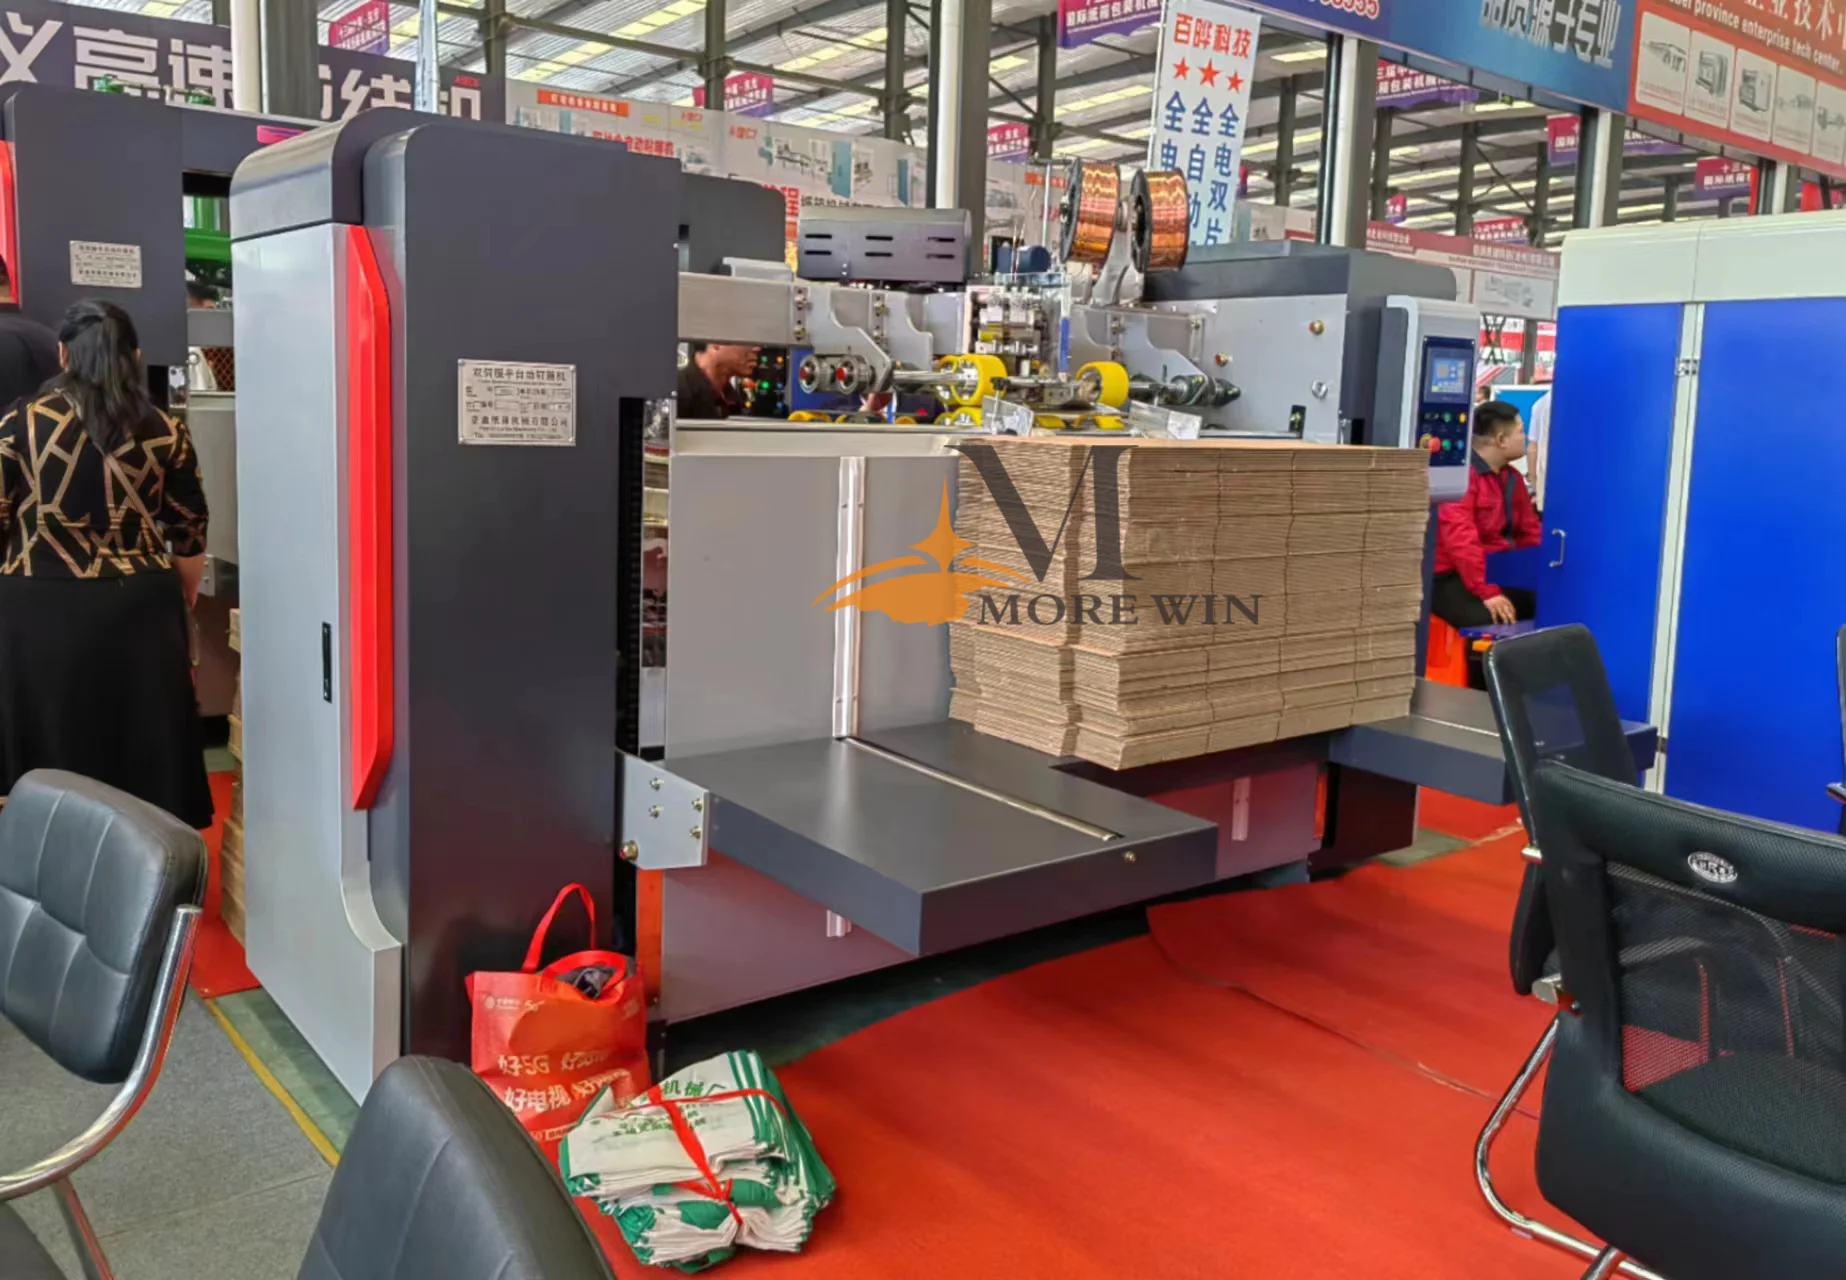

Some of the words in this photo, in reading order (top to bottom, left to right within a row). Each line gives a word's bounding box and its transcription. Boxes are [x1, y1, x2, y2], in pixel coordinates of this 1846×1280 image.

[1694, 0, 1740, 29] province
[1741, 18, 1791, 51] enterprise
[1791, 37, 1812, 60] tech
